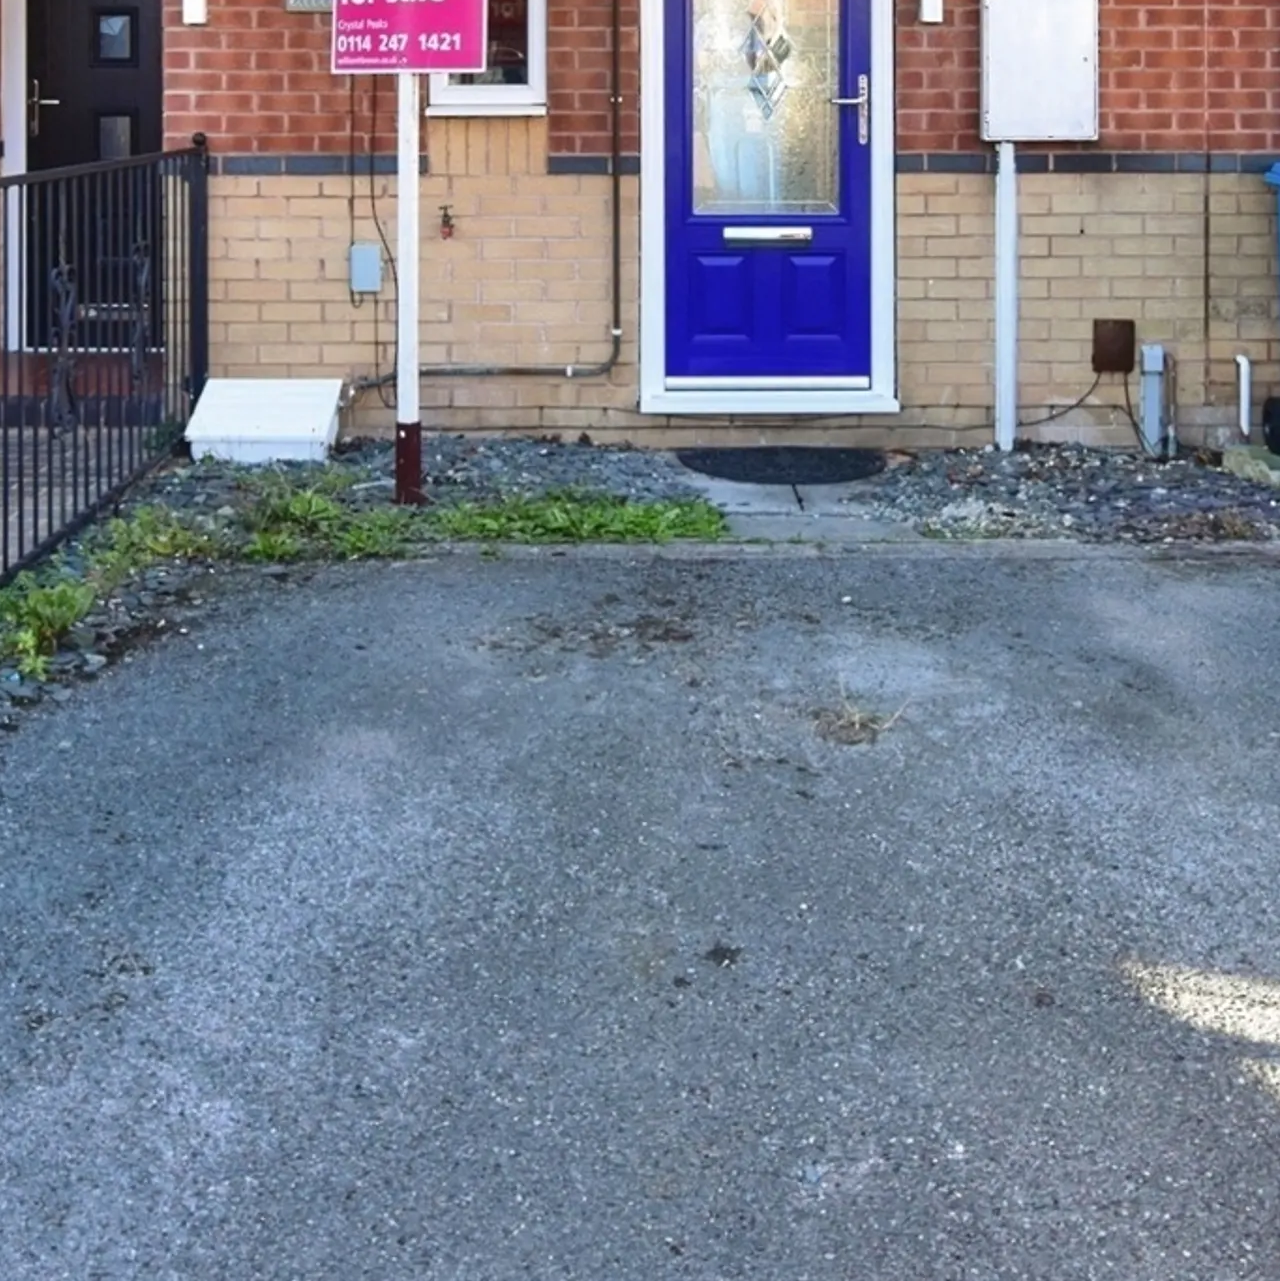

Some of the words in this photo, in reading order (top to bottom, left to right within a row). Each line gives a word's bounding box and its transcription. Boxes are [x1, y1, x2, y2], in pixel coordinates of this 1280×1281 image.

[337, 34, 372, 52] 0114
[378, 33, 409, 52] 247
[418, 32, 462, 51] 1421
